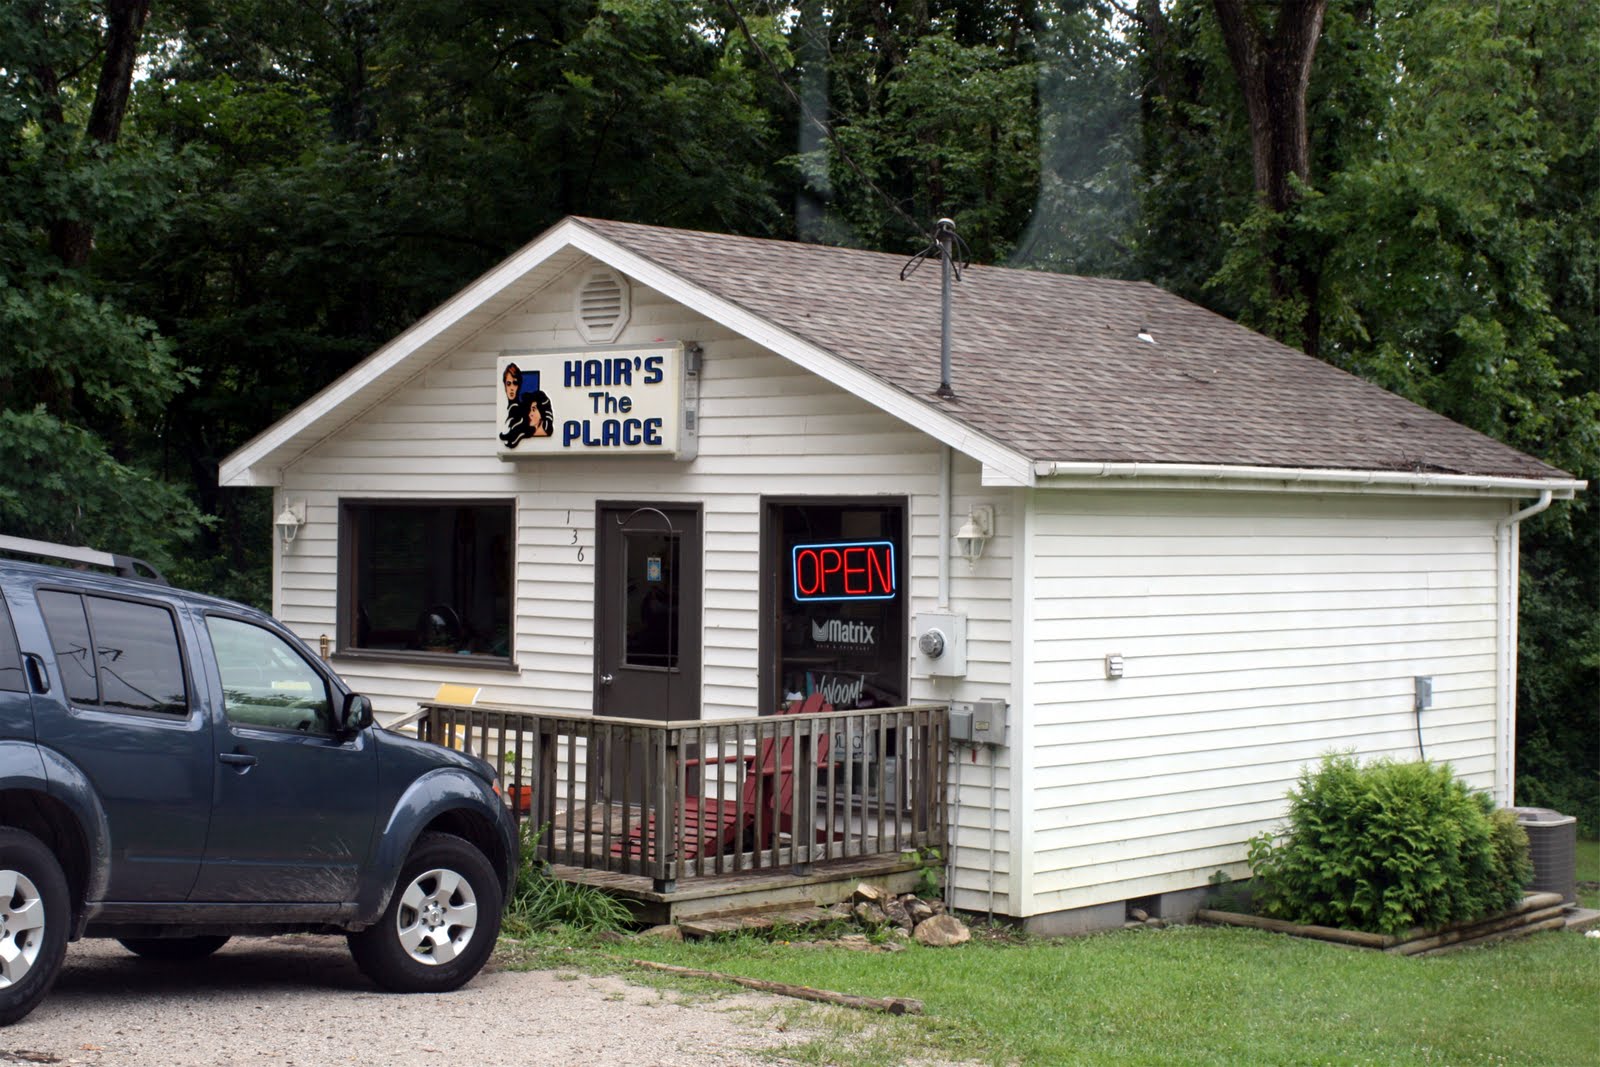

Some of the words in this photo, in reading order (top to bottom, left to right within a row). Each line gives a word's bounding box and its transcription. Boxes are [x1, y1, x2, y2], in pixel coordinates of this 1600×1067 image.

[563, 356, 664, 388] HAIR'S
[588, 391, 633, 414] The
[562, 417, 663, 447] PLACE
[797, 547, 891, 595] OPEN
[829, 619, 875, 644] Matrix
